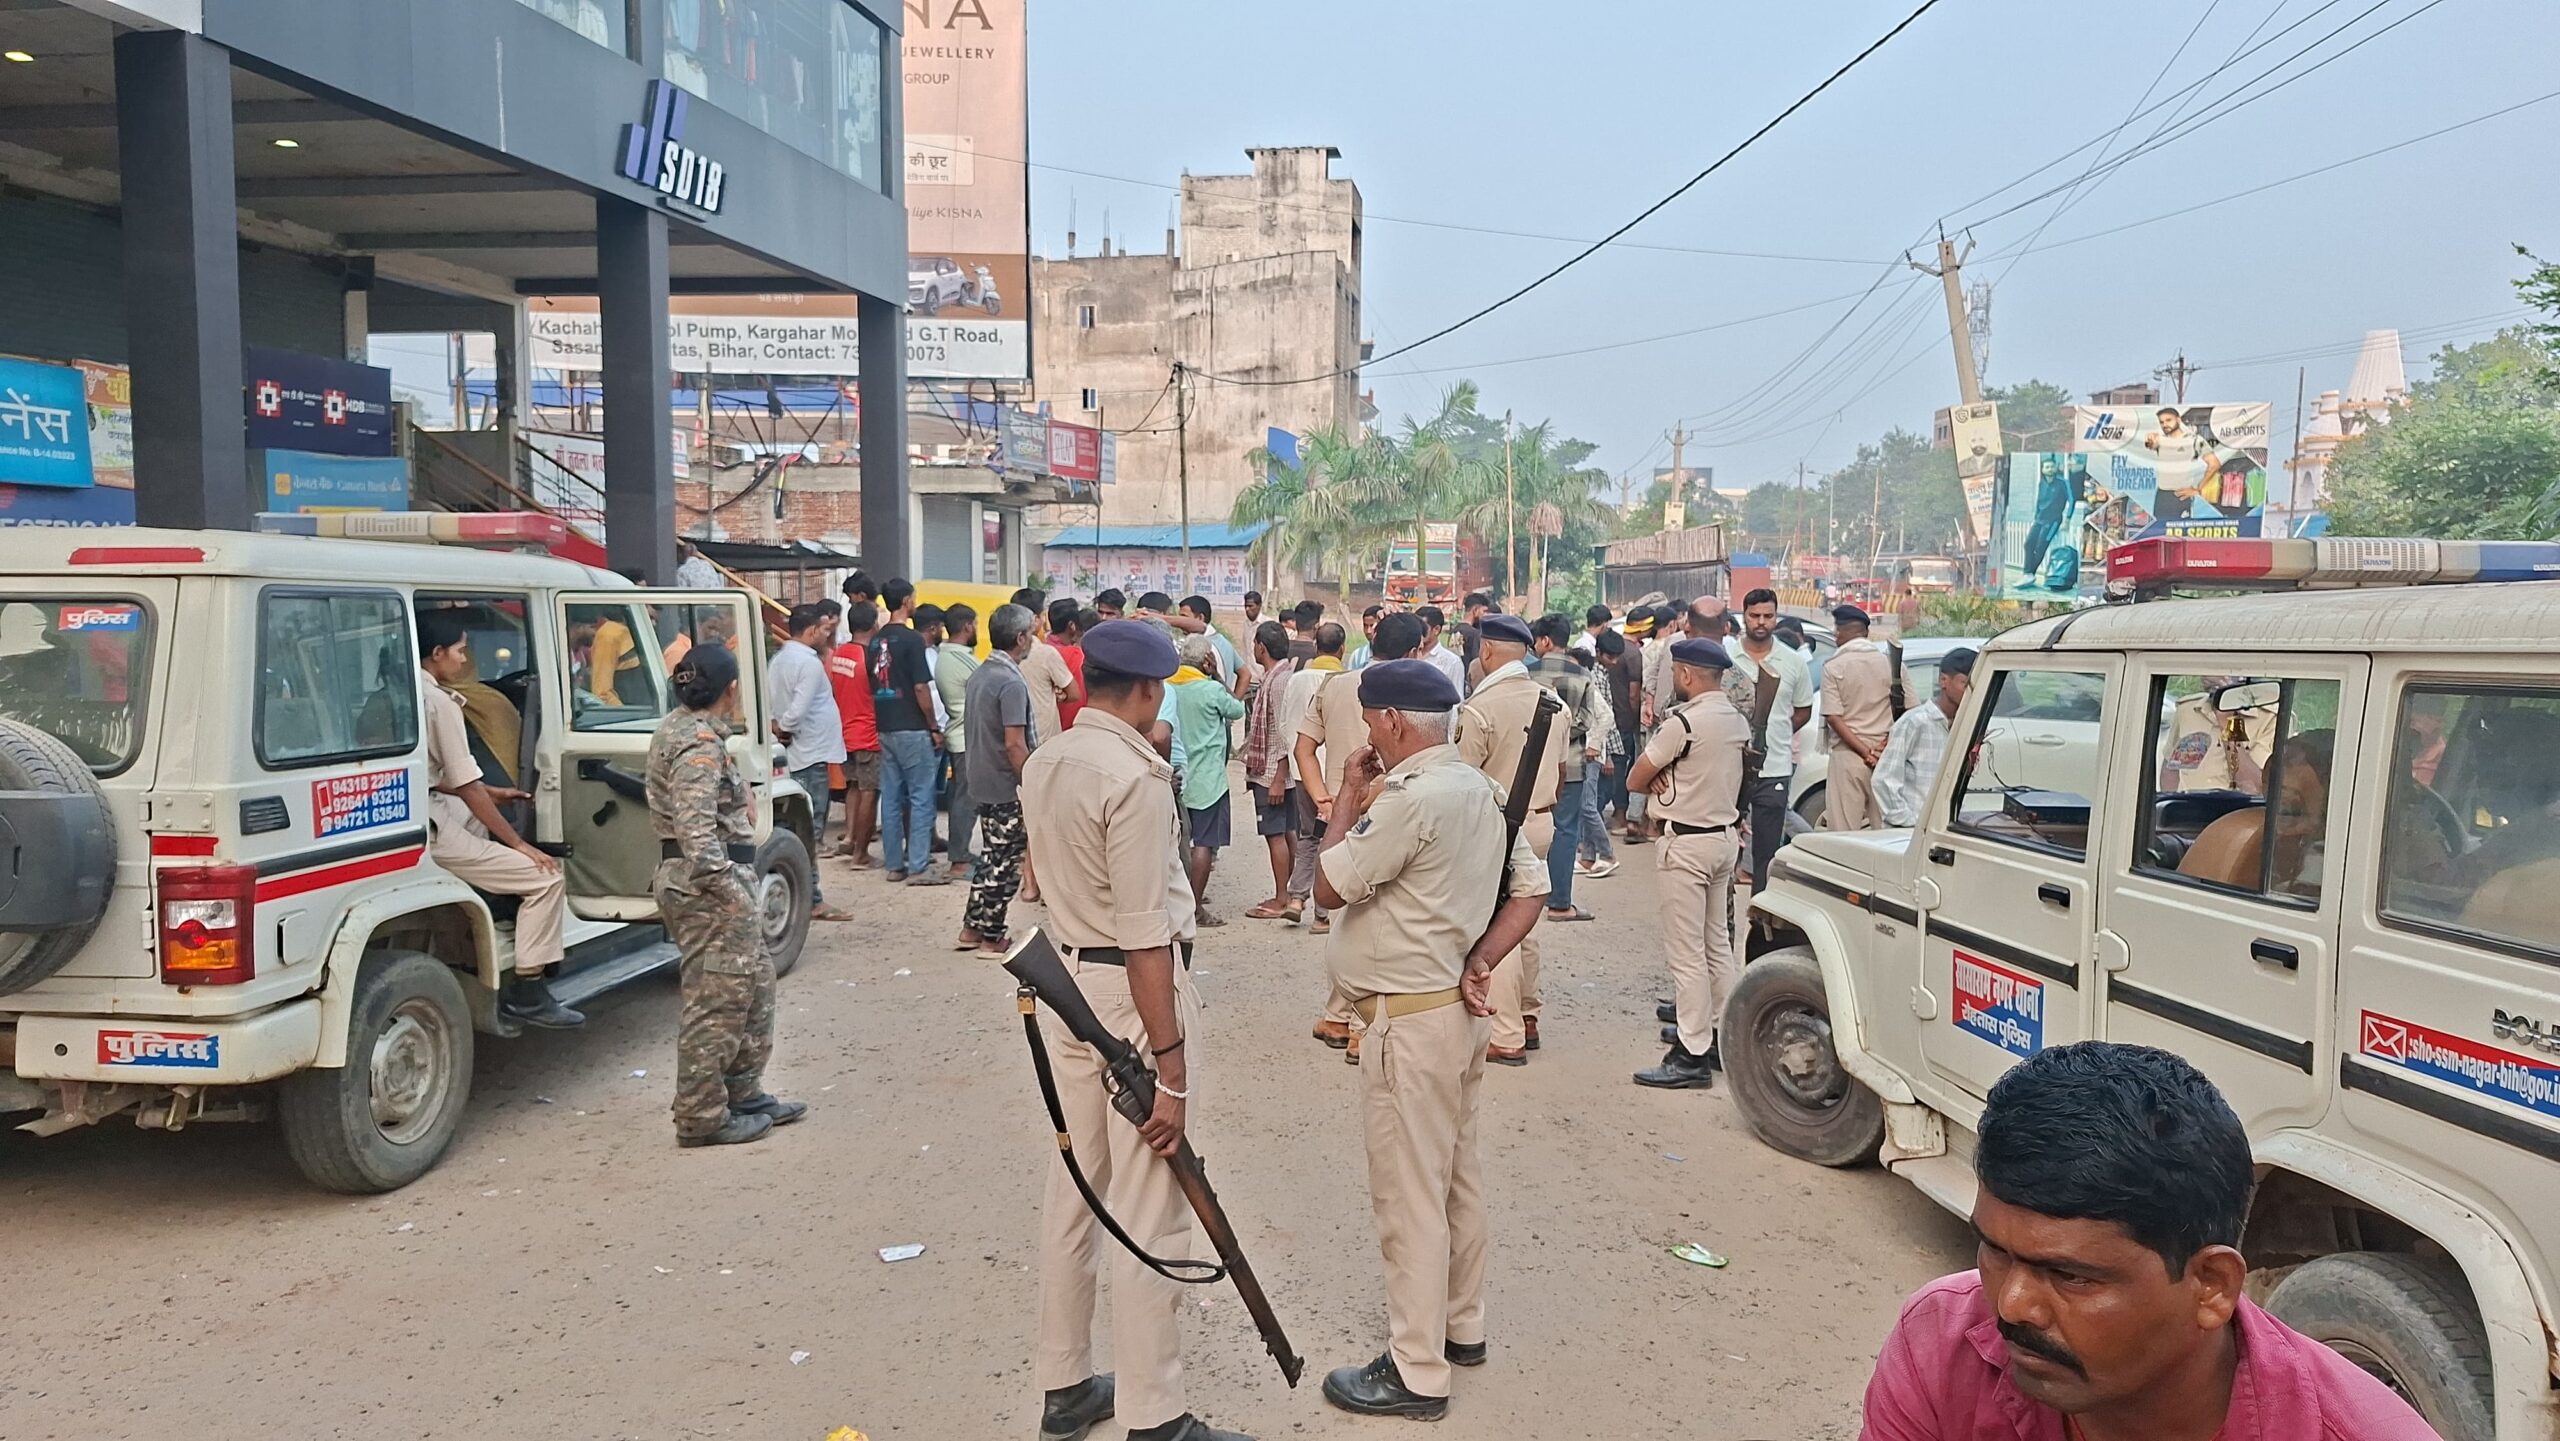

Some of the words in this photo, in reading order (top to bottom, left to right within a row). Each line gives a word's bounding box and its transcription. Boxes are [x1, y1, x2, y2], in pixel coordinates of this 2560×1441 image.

[904, 73, 950, 84] GROUP
[909, 152, 925, 167] की
[927, 155, 949, 170] छूट
[659, 140, 722, 212] SD18
[936, 207, 983, 219] KISNA
[688, 323, 742, 342] Pump,
[748, 325, 826, 343] Kargahar
[919, 327, 949, 342] G.T
[955, 328, 1004, 346] Road,
[709, 344, 758, 361] Bihar,
[763, 344, 836, 361] Contact:
[2220, 426, 2232, 437] AB
[2233, 424, 2266, 438] SPORTS
[2112, 455, 2128, 467] FLY
[2112, 467, 2154, 479] TOWARDS
[2117, 478, 2156, 490] DREAM
[2187, 526, 2238, 538] SPORTS
[67, 609, 131, 629] पुलिस
[334, 810, 368, 830] 94721
[372, 803, 406, 822] 63540
[1999, 1018, 2031, 1049] पुलिस
[104, 1032, 212, 1063] पुलिस
